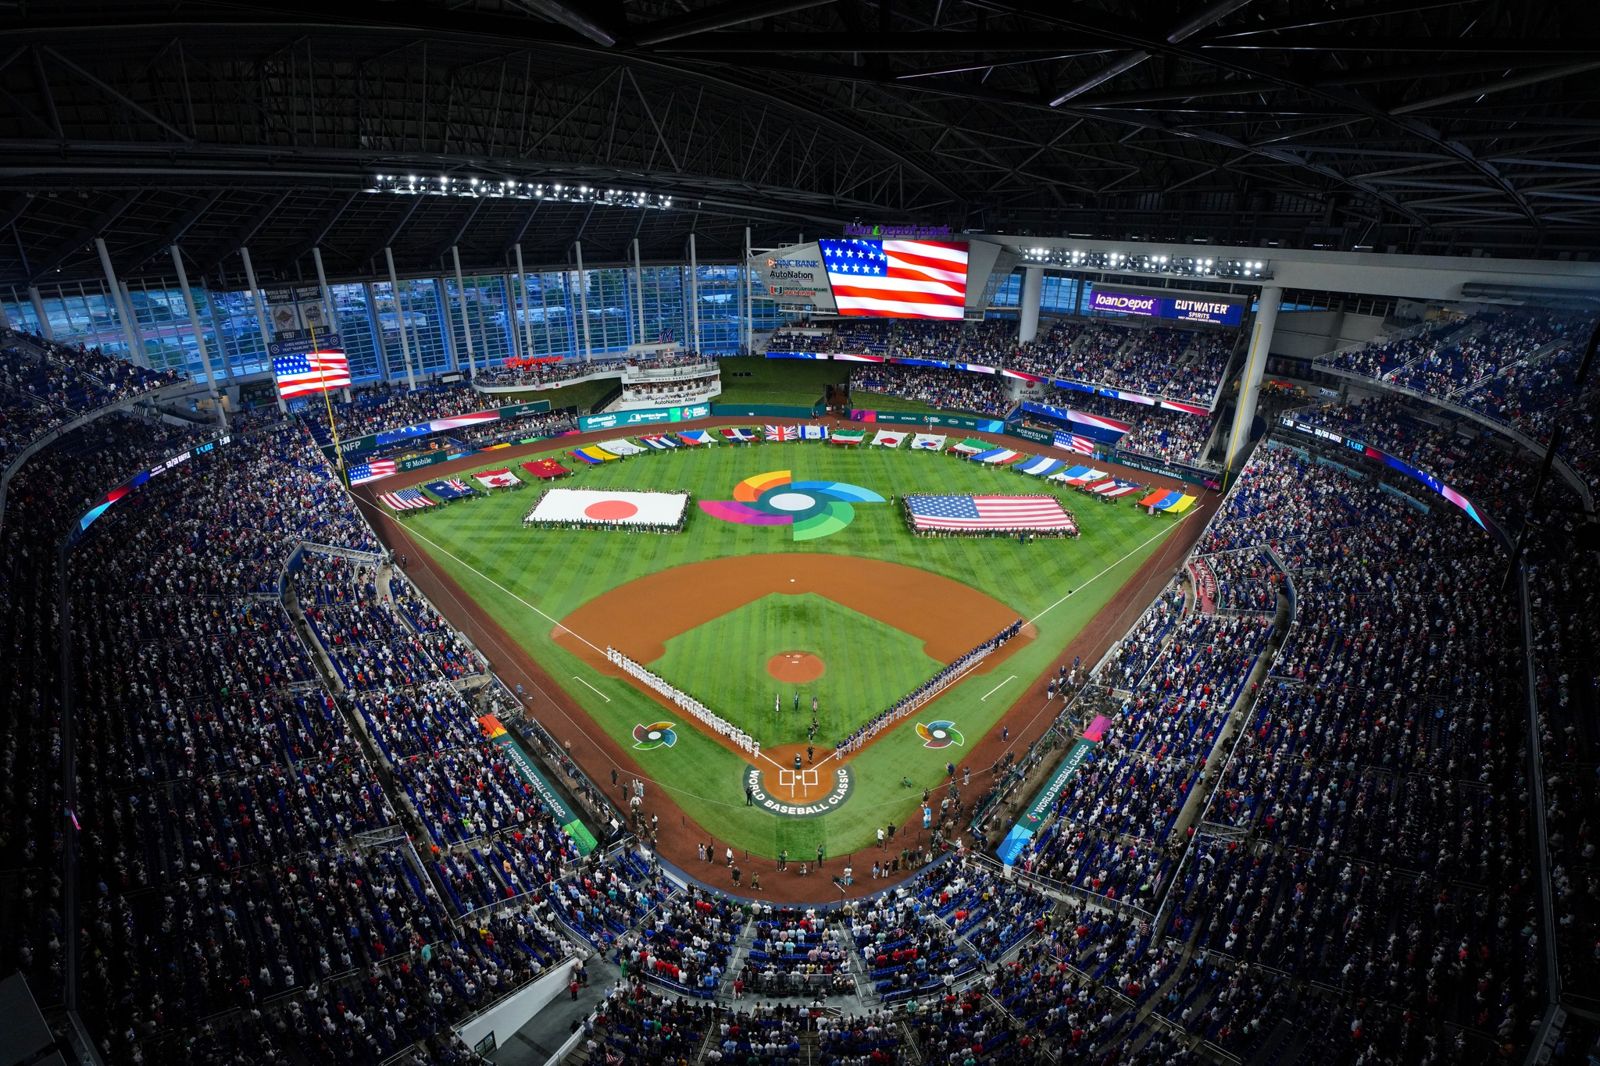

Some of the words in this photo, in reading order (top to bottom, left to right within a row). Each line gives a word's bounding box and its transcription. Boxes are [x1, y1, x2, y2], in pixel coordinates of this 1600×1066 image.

[769, 270, 813, 280] AutoNation
[1095, 293, 1154, 310] loanDepot
[1174, 300, 1227, 315] CUTWATER
[1188, 311, 1210, 320] SPIRITS
[1017, 428, 1048, 440] NORWEGIAN
[343, 440, 360, 452] NFP
[412, 457, 432, 467] Mobile
[1159, 469, 1183, 480] BASEBALL
[508, 748, 526, 769] WORLD
[521, 765, 546, 794] BASEBALL
[543, 792, 566, 818] CLASSIC
[1035, 793, 1055, 813] WORLD
[1051, 764, 1075, 793] BASEBALL
[1070, 744, 1089, 769] CLASSIC
[748, 769, 765, 801] WORLD
[764, 799, 829, 815] BASEBALL
[828, 768, 849, 805] CLASSIC
